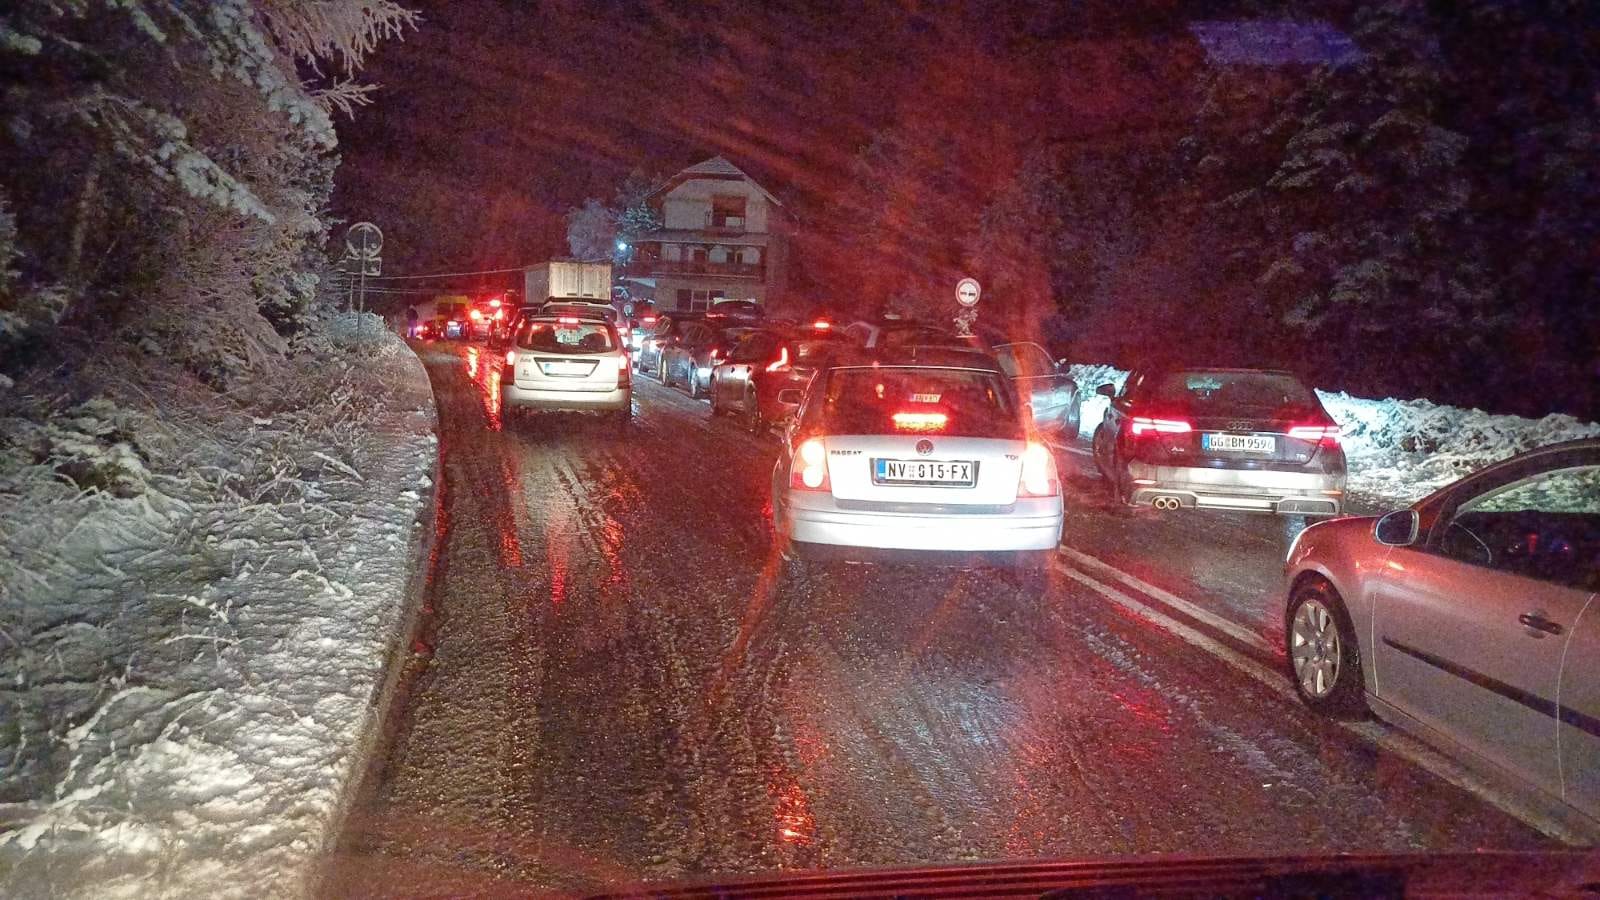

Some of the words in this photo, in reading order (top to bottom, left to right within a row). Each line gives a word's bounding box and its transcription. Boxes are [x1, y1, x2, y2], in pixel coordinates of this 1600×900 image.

[1210, 436, 1224, 448] GG
[1231, 436, 1245, 448] BM
[888, 462, 906, 478] NV
